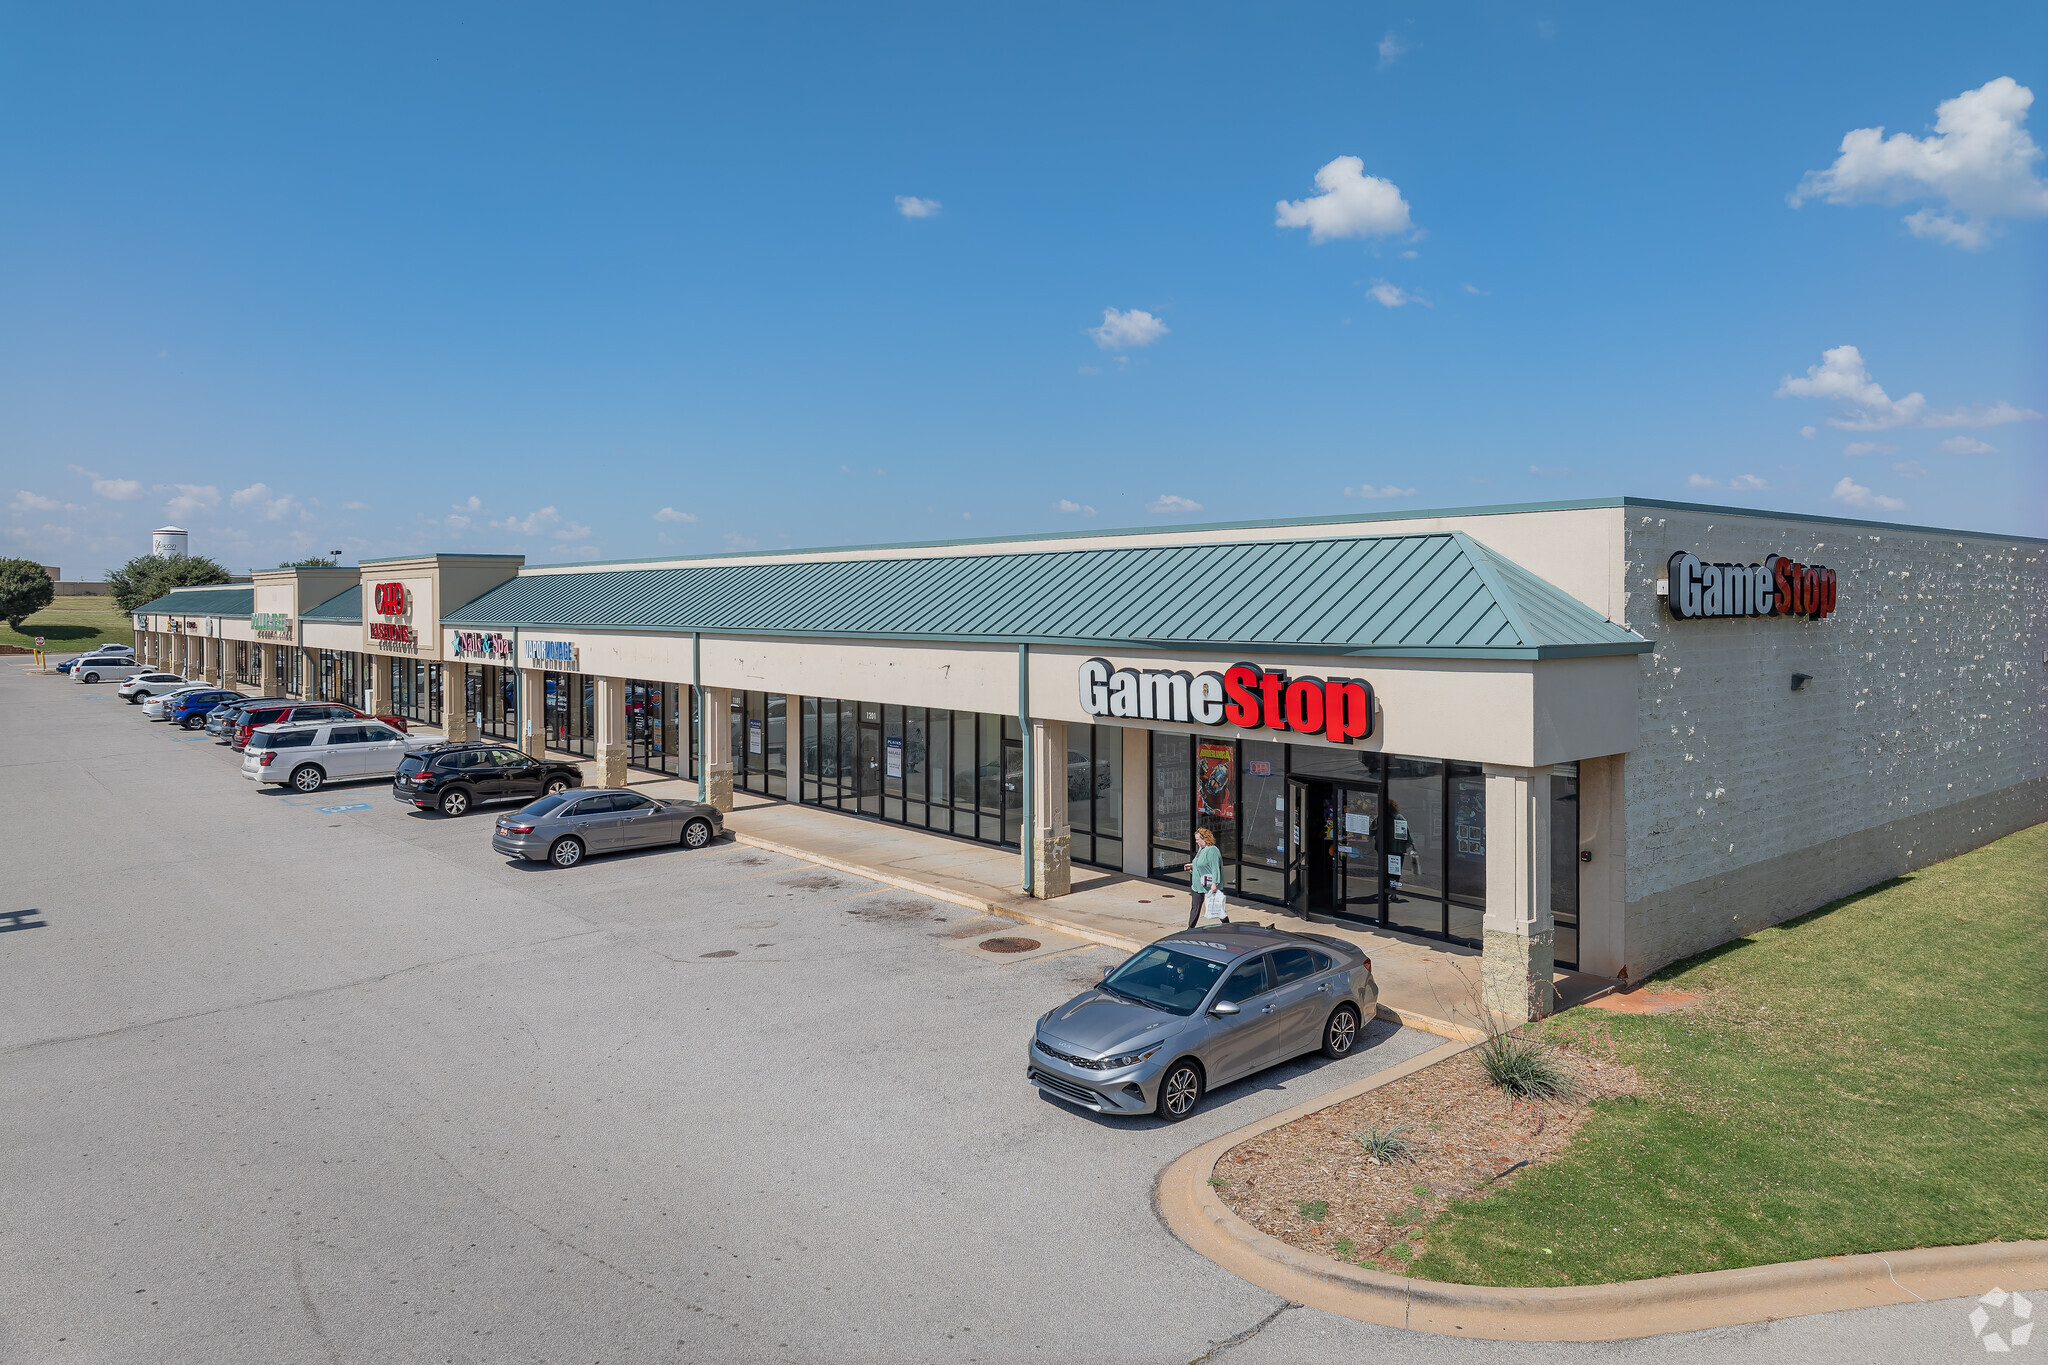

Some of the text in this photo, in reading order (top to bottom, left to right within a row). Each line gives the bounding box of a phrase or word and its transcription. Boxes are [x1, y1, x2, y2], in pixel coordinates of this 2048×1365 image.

[155, 540, 176, 552] Yukon
[374, 583, 404, 615] CATO
[1679, 553, 1837, 619] GameStop
[460, 633, 509, 654] Nails & Spa
[1078, 659, 1368, 743] GameStop
